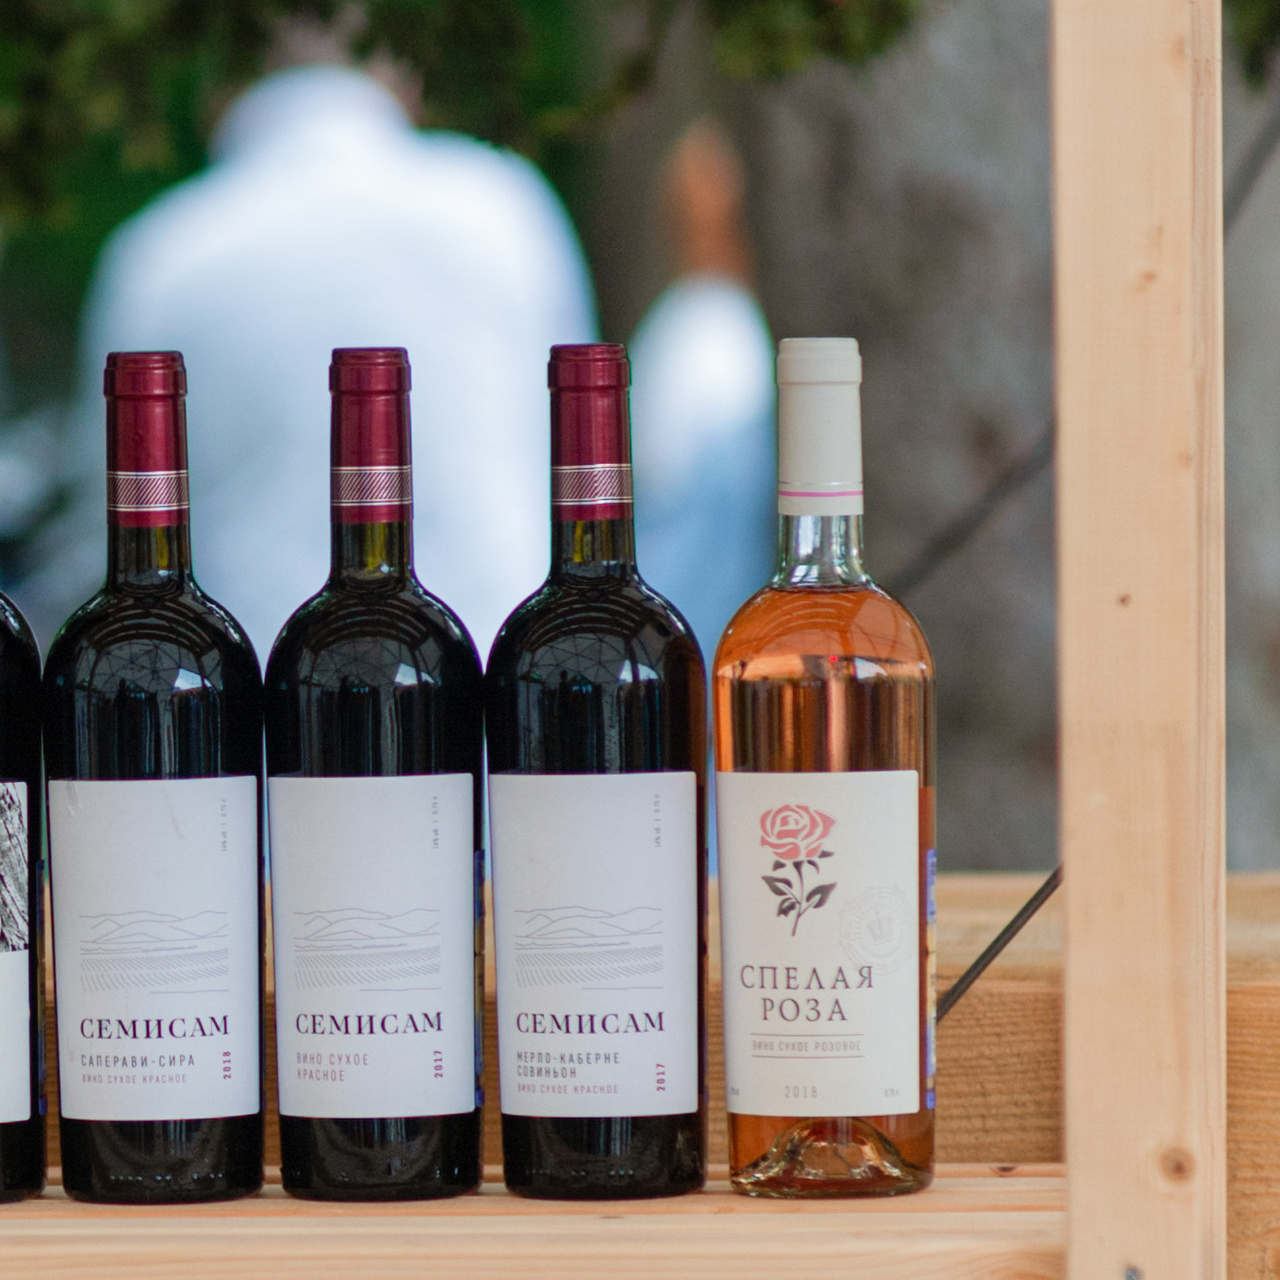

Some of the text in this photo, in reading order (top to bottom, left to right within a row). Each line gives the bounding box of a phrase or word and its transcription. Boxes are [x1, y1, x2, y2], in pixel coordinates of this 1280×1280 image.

[740, 965, 874, 990] СПЕЛАЯ
[762, 998, 848, 1022] РОЗА
[80, 1015, 229, 1039] СЕМИСАМ
[296, 1011, 444, 1035] СЕМИСАМ
[516, 1011, 665, 1035] СЕМИСАМ
[752, 1040, 862, 1052] ВИНО СУХОЕ РОЗОВОЕ
[81, 1054, 195, 1068] САПЕРАВИ-СИРА
[296, 1052, 369, 1066] ВИНО СУХОЕ
[433, 1050, 444, 1079] 2017
[517, 1051, 620, 1065] МЕРЛО-КАБЕРНЕ
[222, 1051, 232, 1080] 2018
[517, 1065, 577, 1079] СОВИНЬОН
[82, 1073, 187, 1084] ВИНО СУХОЕ КРАСНОЕ
[296, 1069, 345, 1082] КРАСНОЕ
[656, 1063, 666, 1092] 2017
[517, 1083, 618, 1095] ВИНО СУХОЕ КРАСНОЕ
[784, 1085, 818, 1099] 2018
